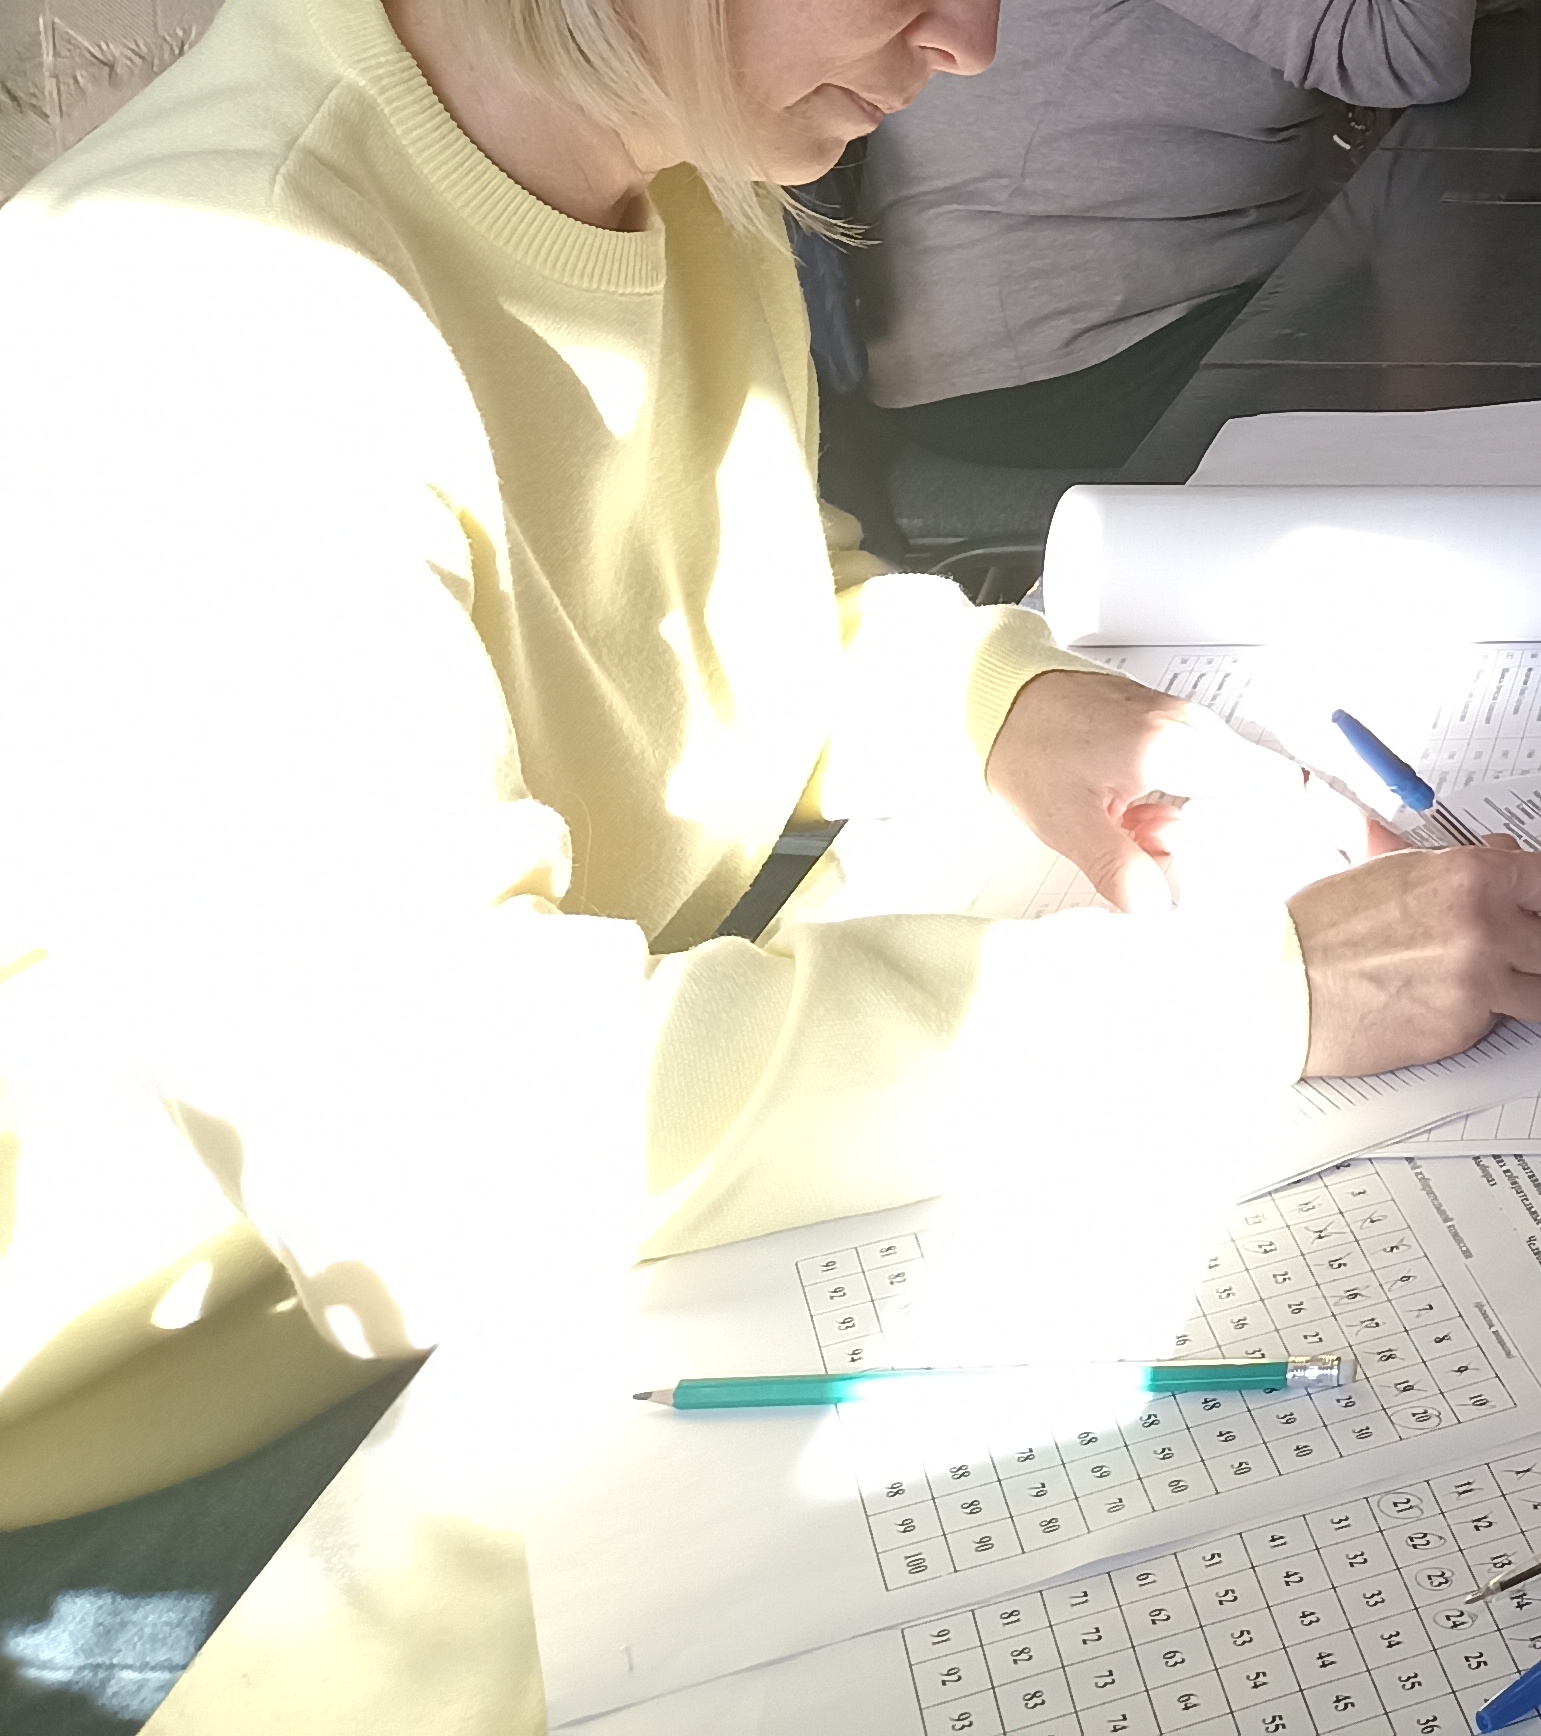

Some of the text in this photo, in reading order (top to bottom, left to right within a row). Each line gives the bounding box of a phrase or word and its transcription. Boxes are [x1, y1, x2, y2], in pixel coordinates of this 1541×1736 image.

[820, 1260, 928, 1575] 91 92 93 94 98 99 100
[879, 1245, 995, 1553] 81 82 88 89 90
[1216, 1286, 1236, 1300] 35
[1229, 1316, 1248, 1330] 36
[1276, 1411, 1298, 1425] 39
[1293, 1444, 1313, 1458] 40
[1272, 1270, 1292, 1285] 25
[1287, 1300, 1308, 1315] 26
[1303, 1331, 1323, 1344] 27
[1336, 1394, 1356, 1408] 29
[1352, 1426, 1373, 1440] 30
[1411, 1409, 1431, 1422] 20
[1016, 1447, 1061, 1534] 78 79 80
[1077, 1431, 1125, 1514] 68 69 70
[1139, 1413, 1189, 1494] 58 59 60
[1201, 1397, 1252, 1476] 48 49 50
[1269, 1534, 1356, 1712] 41 42 43 44 45
[1330, 1515, 1443, 1735] 31 32 33 34 35 36
[1392, 1497, 1488, 1671] 21 22 23 24 25
[1472, 1515, 1493, 1532] 12
[1491, 1553, 1512, 1569] 13
[1511, 1592, 1533, 1611] 14
[930, 1628, 974, 1731] 91 92 93
[1000, 1609, 1046, 1710] 81 82 83
[1069, 1590, 1131, 1733] 71 72 73 74
[1136, 1572, 1201, 1711] 61 62 63 64
[1202, 1552, 1287, 1734] 51 52 53 54 55
